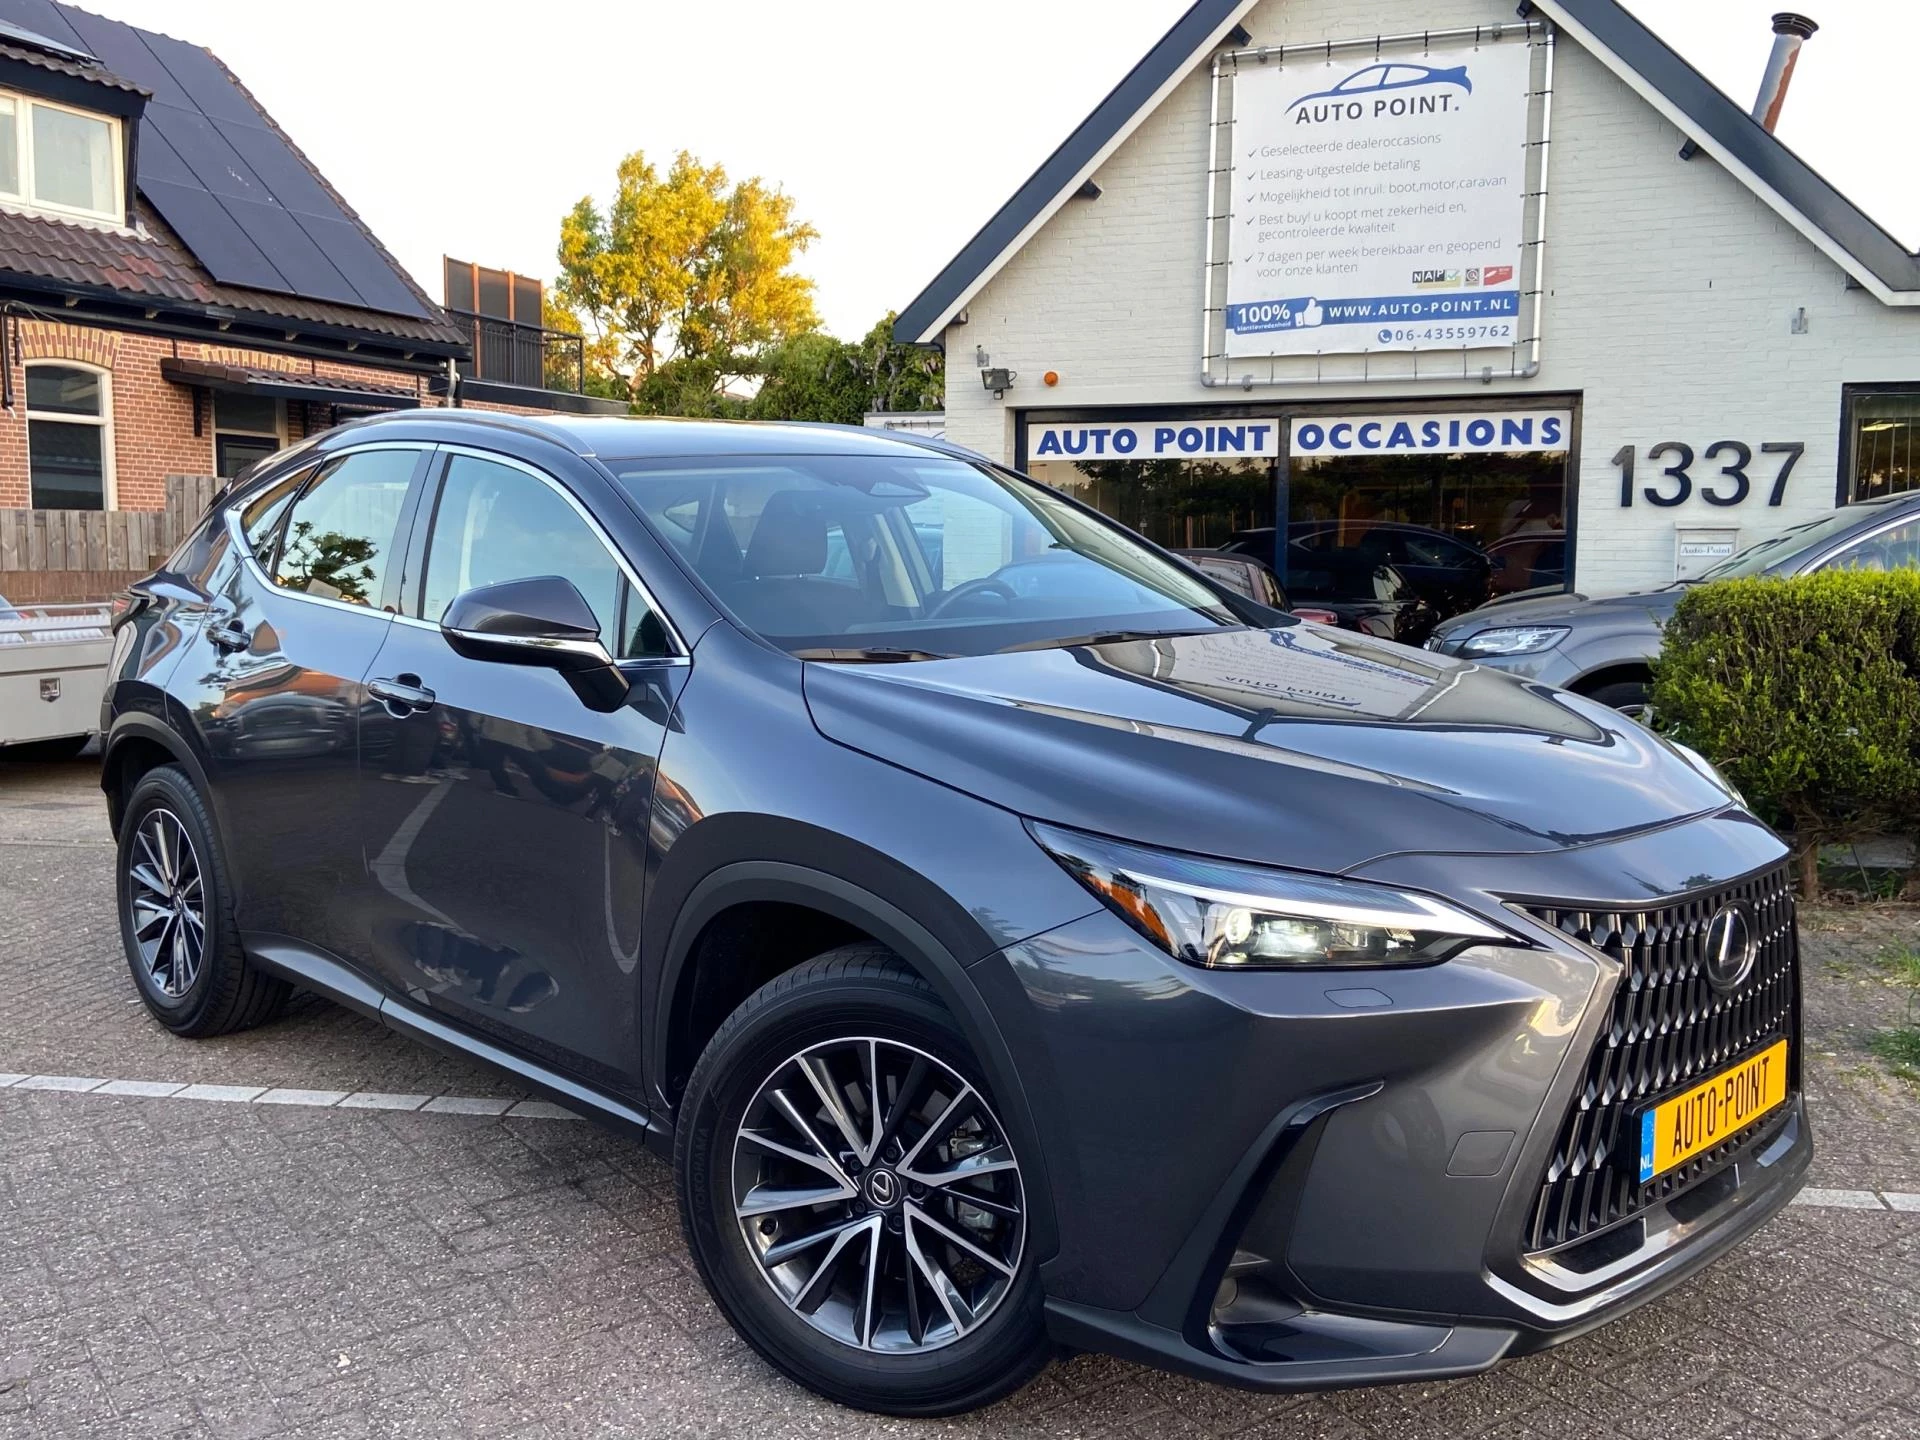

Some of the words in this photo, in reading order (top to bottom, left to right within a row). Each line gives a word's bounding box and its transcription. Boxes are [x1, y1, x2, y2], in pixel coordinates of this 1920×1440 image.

[1296, 102, 1363, 125] AUTO
[1260, 140, 1343, 158] Geselecteerde
[1346, 133, 1442, 151] dealeroccasions
[1373, 158, 1421, 172] betaling
[1260, 187, 1331, 205] Mogelijkheid
[1334, 185, 1350, 198] tot
[1259, 214, 1284, 226] Best
[1313, 213, 1321, 222] u
[1325, 209, 1357, 222] koopt
[1361, 207, 1384, 219] met
[1387, 202, 1446, 217] zekerheid
[1258, 225, 1345, 243] gecontroleerde
[1348, 222, 1396, 235] kwaliteit
[1258, 252, 1265, 263] 7
[1267, 251, 1302, 265] dagen
[1305, 250, 1326, 263] per
[1328, 246, 1359, 259] week
[1361, 242, 1425, 257] bereikbaar
[1428, 243, 1444, 254] en
[1446, 237, 1501, 255] geopend
[1257, 267, 1282, 278] voor
[1284, 264, 1313, 276] onze
[1316, 262, 1359, 275] klanten
[1413, 269, 1445, 283] NAP
[1237, 303, 1290, 324] 100%
[1329, 298, 1512, 318] WWW.AUTO-POINT.NL
[1395, 325, 1510, 342] 06-43559762
[1036, 427, 1138, 456] AUTO
[1154, 424, 1271, 454] POINT
[1297, 416, 1562, 451] OCCASIONS
[1611, 440, 1804, 507] 1337
[1672, 1056, 1770, 1157] AUTO-POINT
[1640, 1154, 1653, 1171] NL
